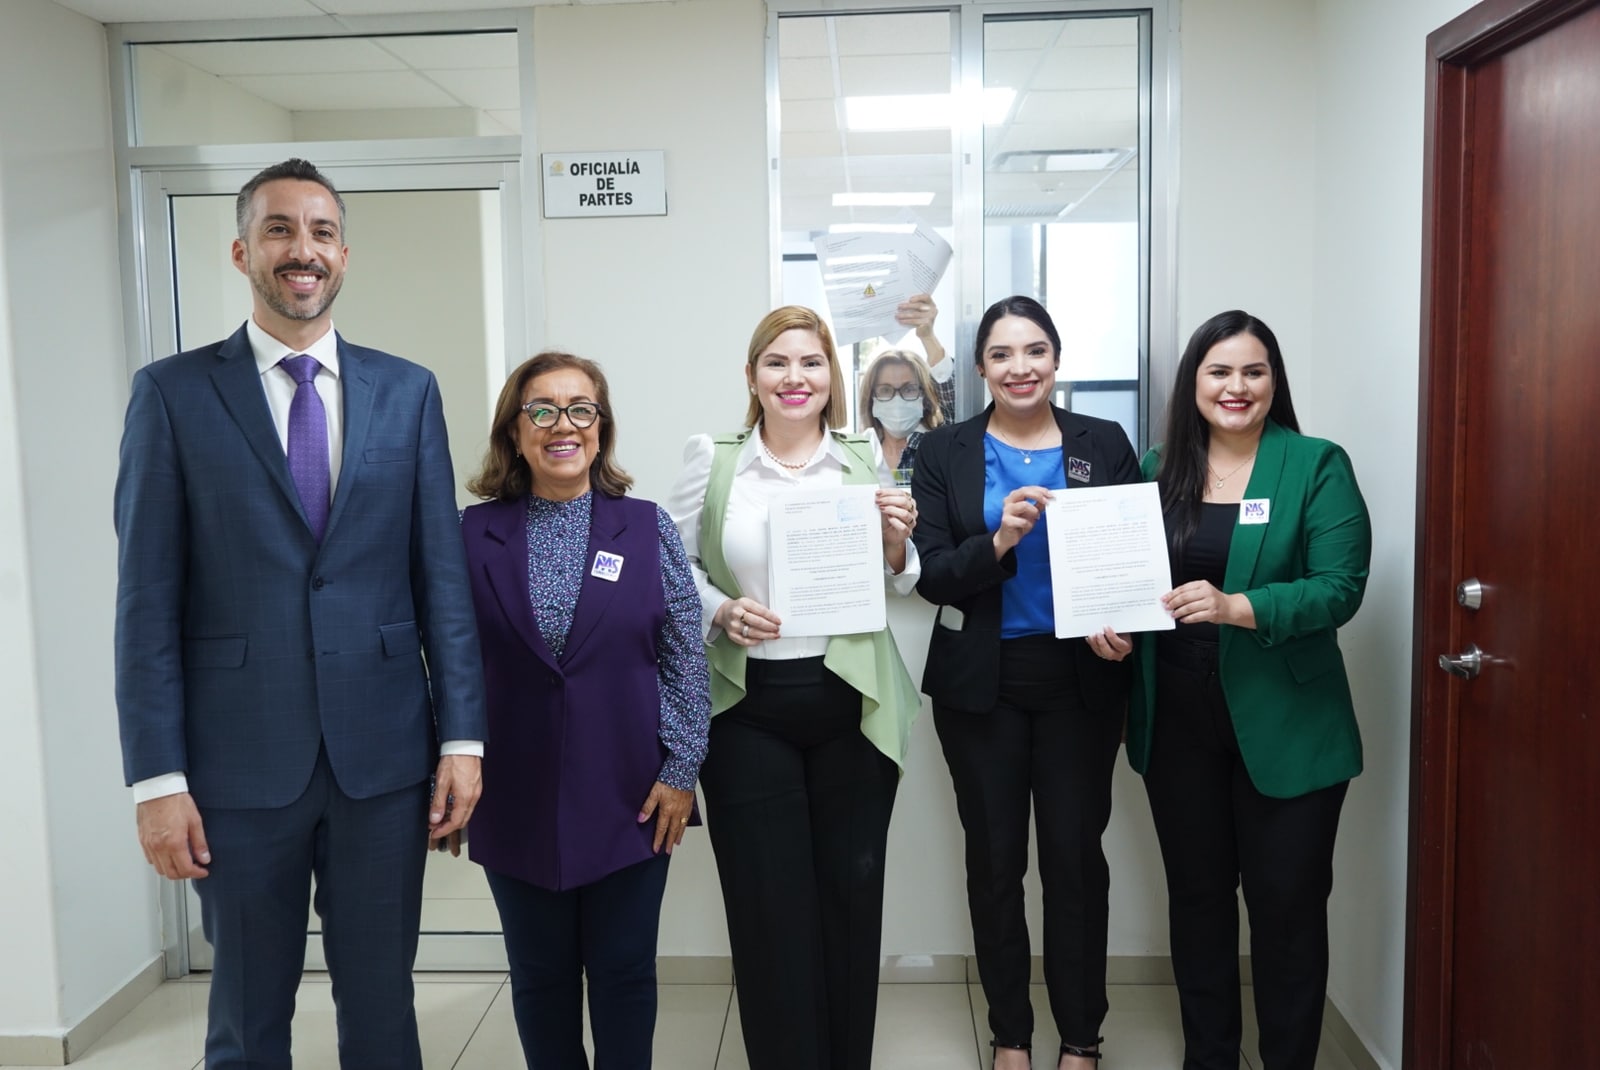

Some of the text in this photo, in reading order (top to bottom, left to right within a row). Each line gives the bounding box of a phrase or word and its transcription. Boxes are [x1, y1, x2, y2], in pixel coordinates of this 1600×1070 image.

[570, 158, 640, 176] OFICIALÍA
[596, 177, 615, 191] DE
[579, 192, 633, 206] PARTES
